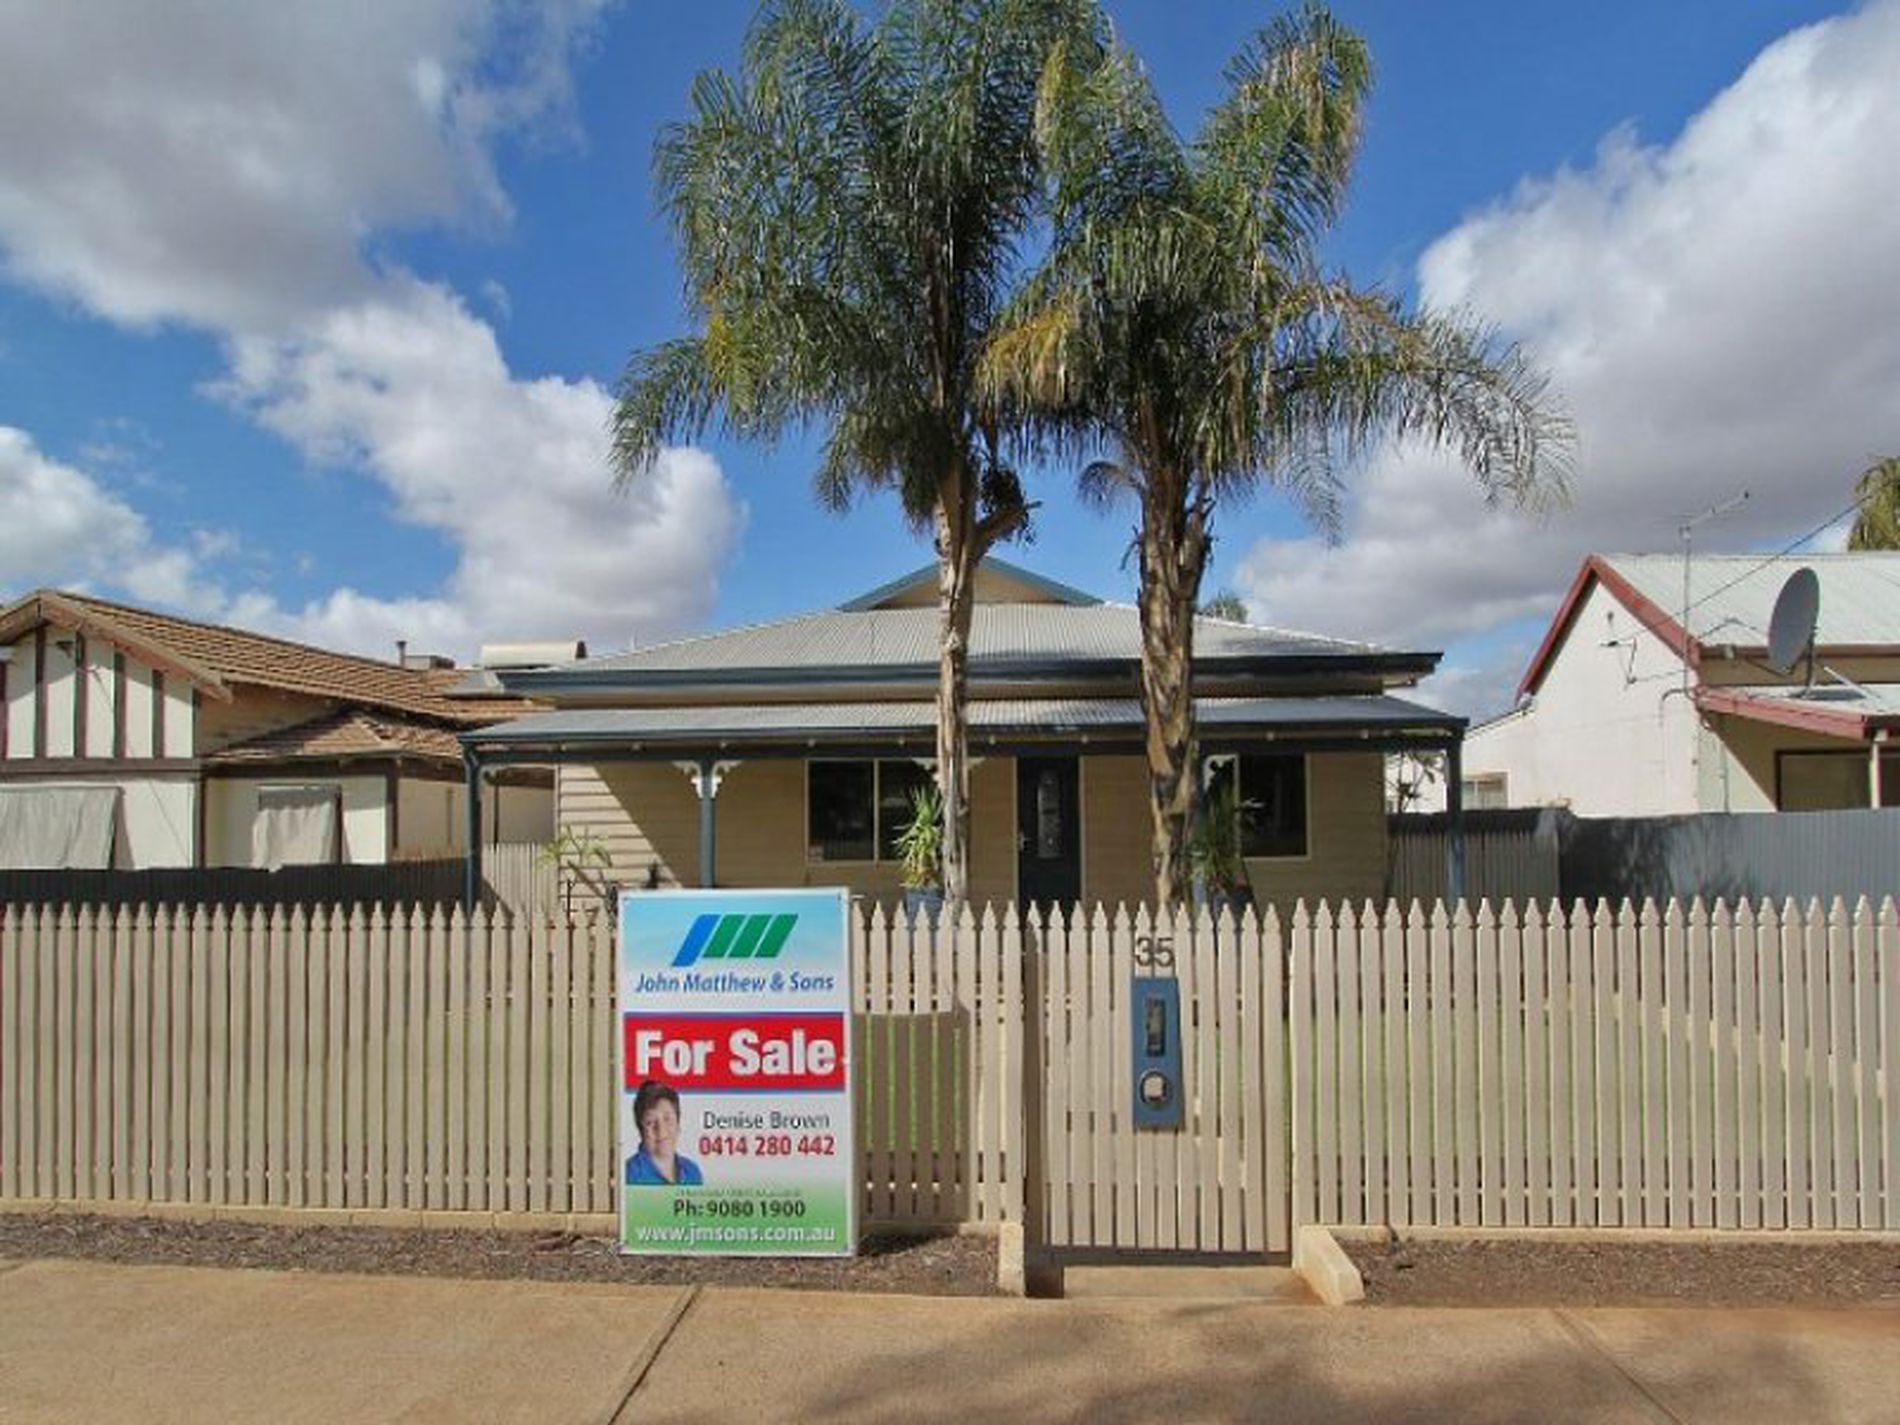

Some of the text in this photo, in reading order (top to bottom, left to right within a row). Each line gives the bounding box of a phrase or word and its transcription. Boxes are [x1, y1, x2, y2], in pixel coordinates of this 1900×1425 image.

[1135, 936, 1175, 968] 35
[636, 972, 834, 993] John Matthew & Sons
[635, 1028, 836, 1076] For Sale
[703, 1111, 830, 1130] Denise Brown
[698, 1135, 835, 1156] 0414 280 442
[673, 1199, 806, 1217] Ph: 9080 1900
[635, 1221, 836, 1245] www.jmsons.com.au
